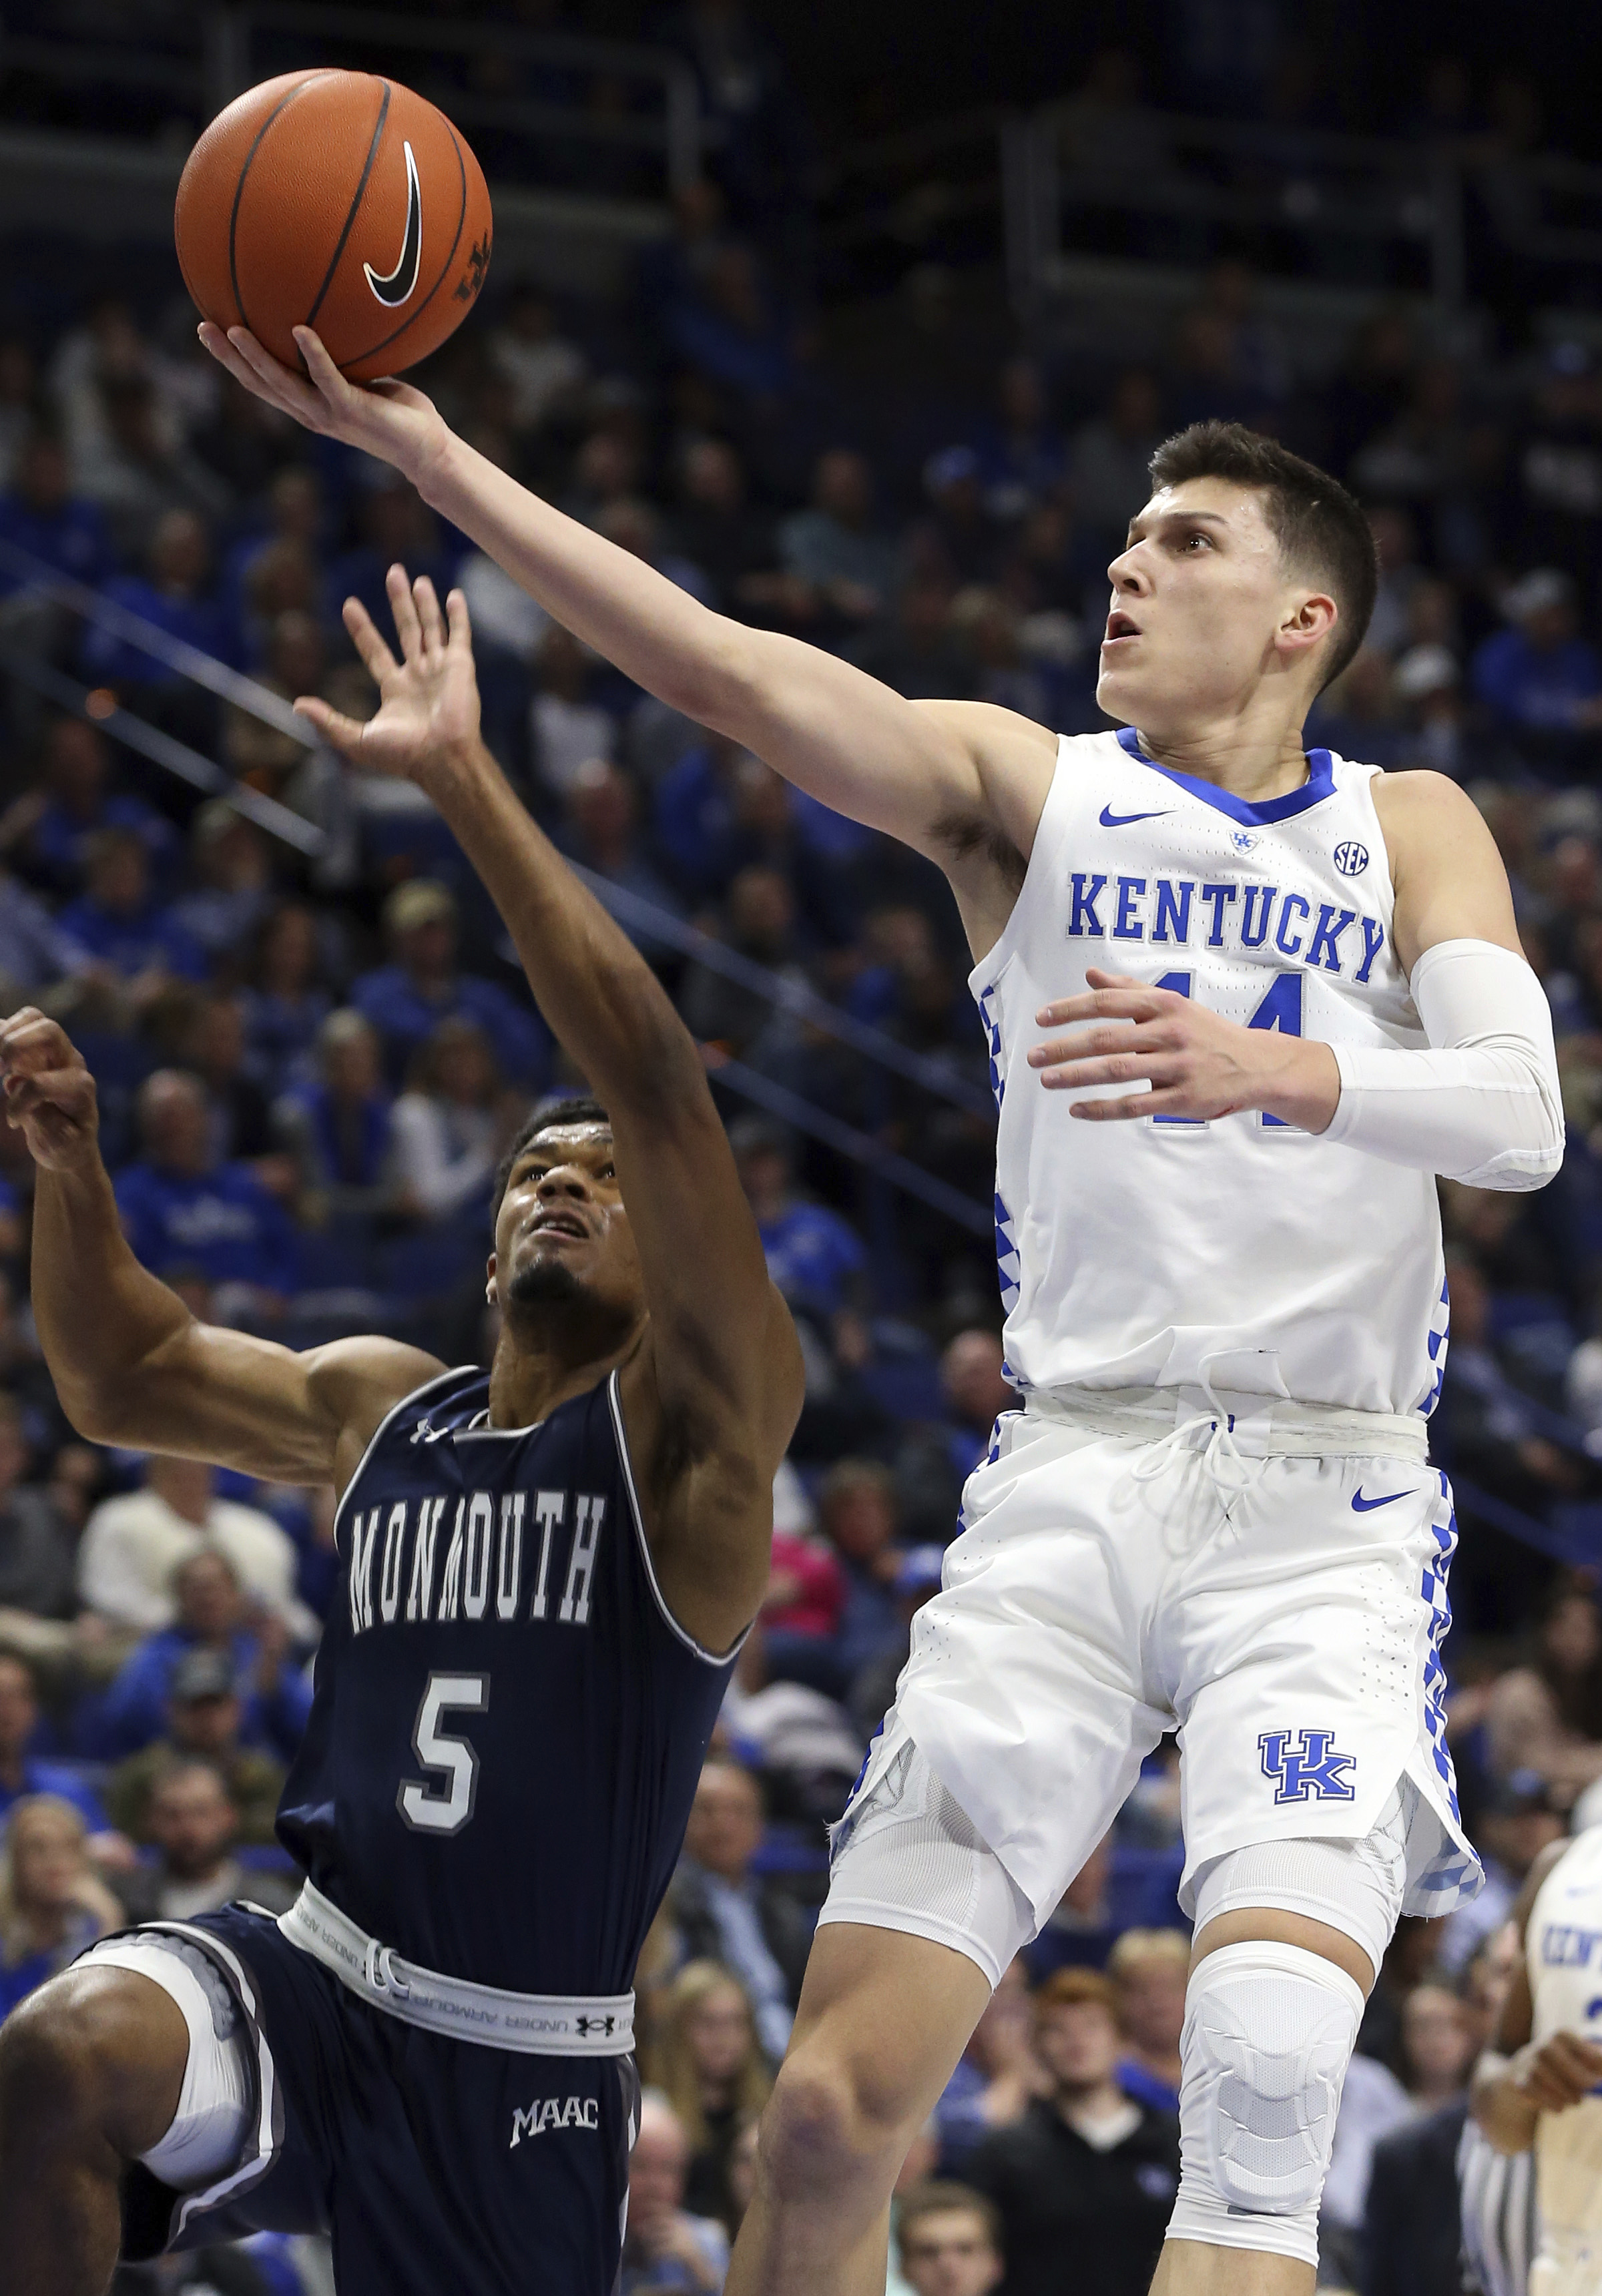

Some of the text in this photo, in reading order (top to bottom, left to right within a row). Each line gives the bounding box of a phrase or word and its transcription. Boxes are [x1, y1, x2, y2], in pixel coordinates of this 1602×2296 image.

[1335, 841, 1368, 876] SEC
[1067, 871, 1386, 985] KENTUCKY
[347, 1490, 606, 1637] MONMOUTH
[396, 1670, 491, 1837] 5
[505, 2015, 569, 2033] UNDER
[509, 2096, 599, 2149] MAAC
